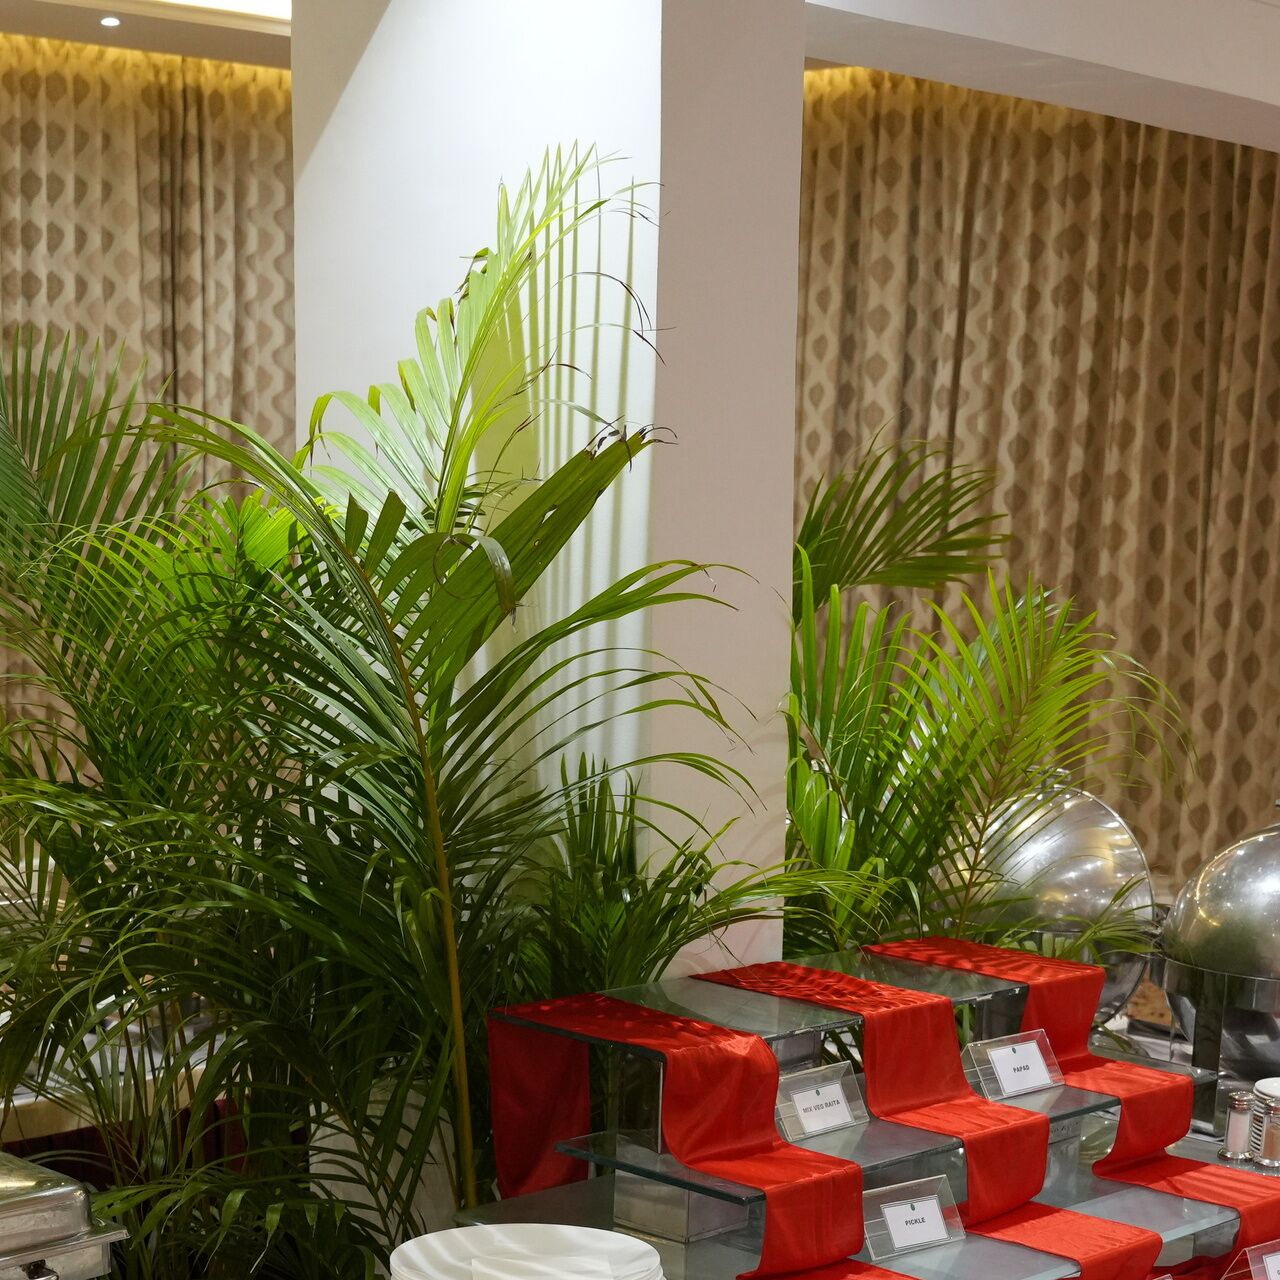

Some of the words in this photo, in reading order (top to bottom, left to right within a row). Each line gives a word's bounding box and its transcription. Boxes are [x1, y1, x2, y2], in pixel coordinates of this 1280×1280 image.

[1013, 1064, 1030, 1073] PAPAD
[802, 1104, 813, 1113] MIX
[814, 1103, 825, 1111] VEG
[825, 1099, 841, 1108] RAITA
[904, 1216, 926, 1226] PICKLE
